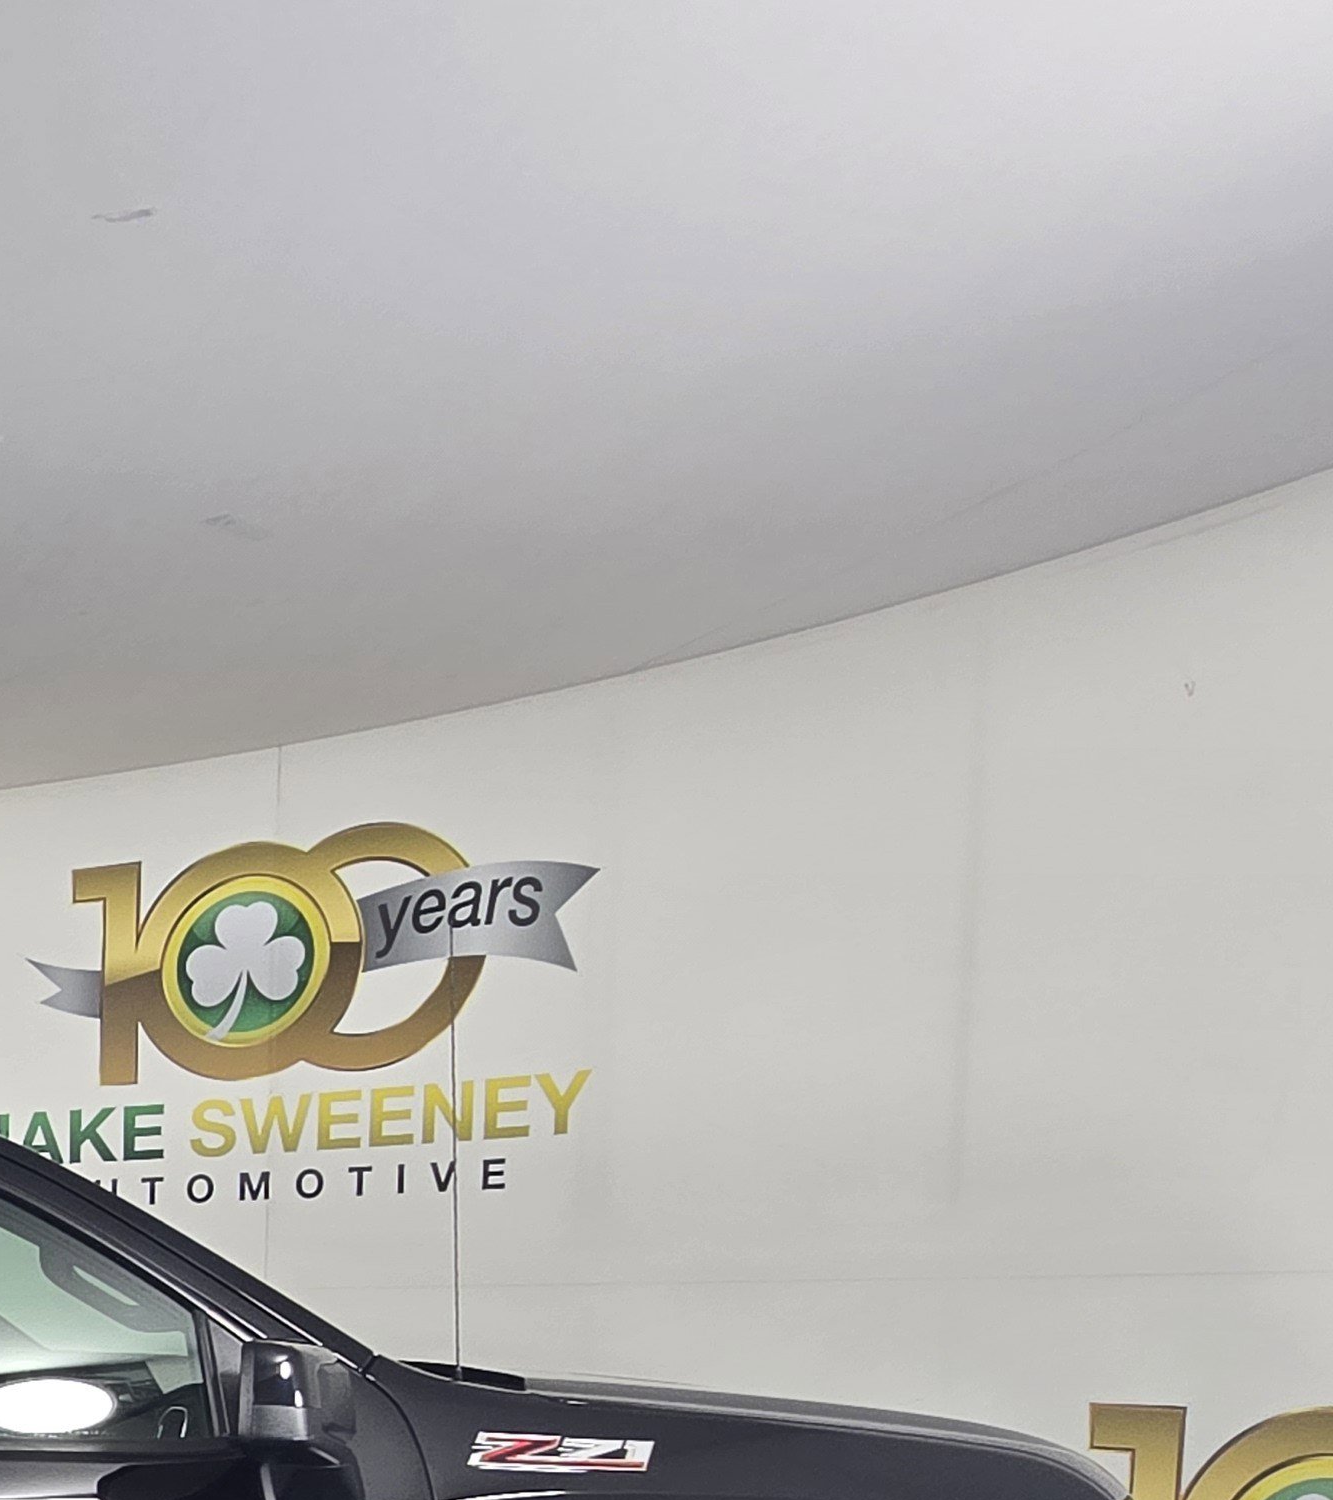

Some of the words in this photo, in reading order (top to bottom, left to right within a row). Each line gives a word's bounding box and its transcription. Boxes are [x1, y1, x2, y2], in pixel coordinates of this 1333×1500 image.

[72, 821, 485, 1085] 100
[376, 874, 543, 957] years
[190, 1068, 592, 1157] SWEENEY
[94, 1157, 507, 1205] TOMOTIVE
[467, 1431, 654, 1472] Z71
